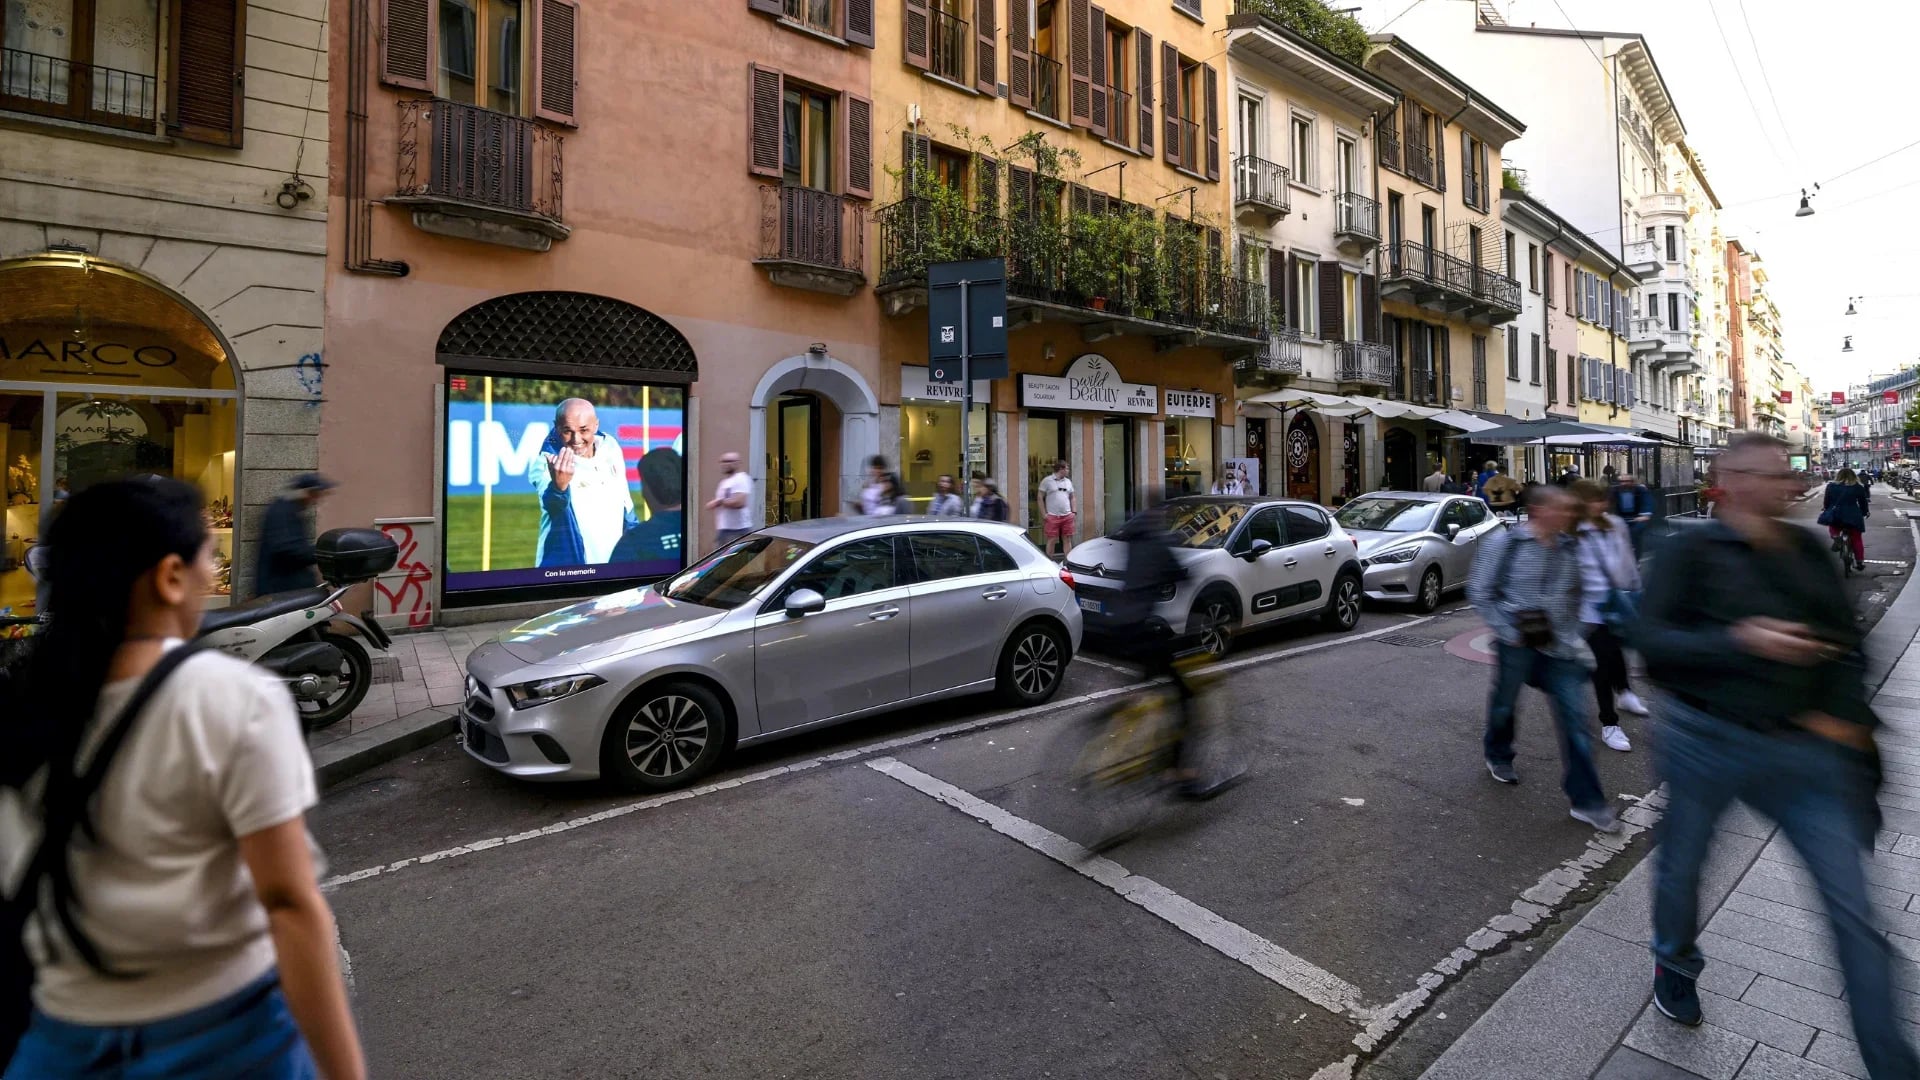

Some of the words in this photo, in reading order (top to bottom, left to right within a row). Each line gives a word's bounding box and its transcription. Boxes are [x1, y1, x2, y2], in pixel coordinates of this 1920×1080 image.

[0, 337, 177, 367] ARCO
[1080, 371, 1110, 390] wild
[1069, 377, 1120, 409] Beauty
[1167, 393, 1211, 409] EUTERPE
[1127, 396, 1155, 408] REVIVRE
[544, 570, 559, 578] Con
[559, 569, 566, 577] la
[567, 567, 596, 576] memoria
